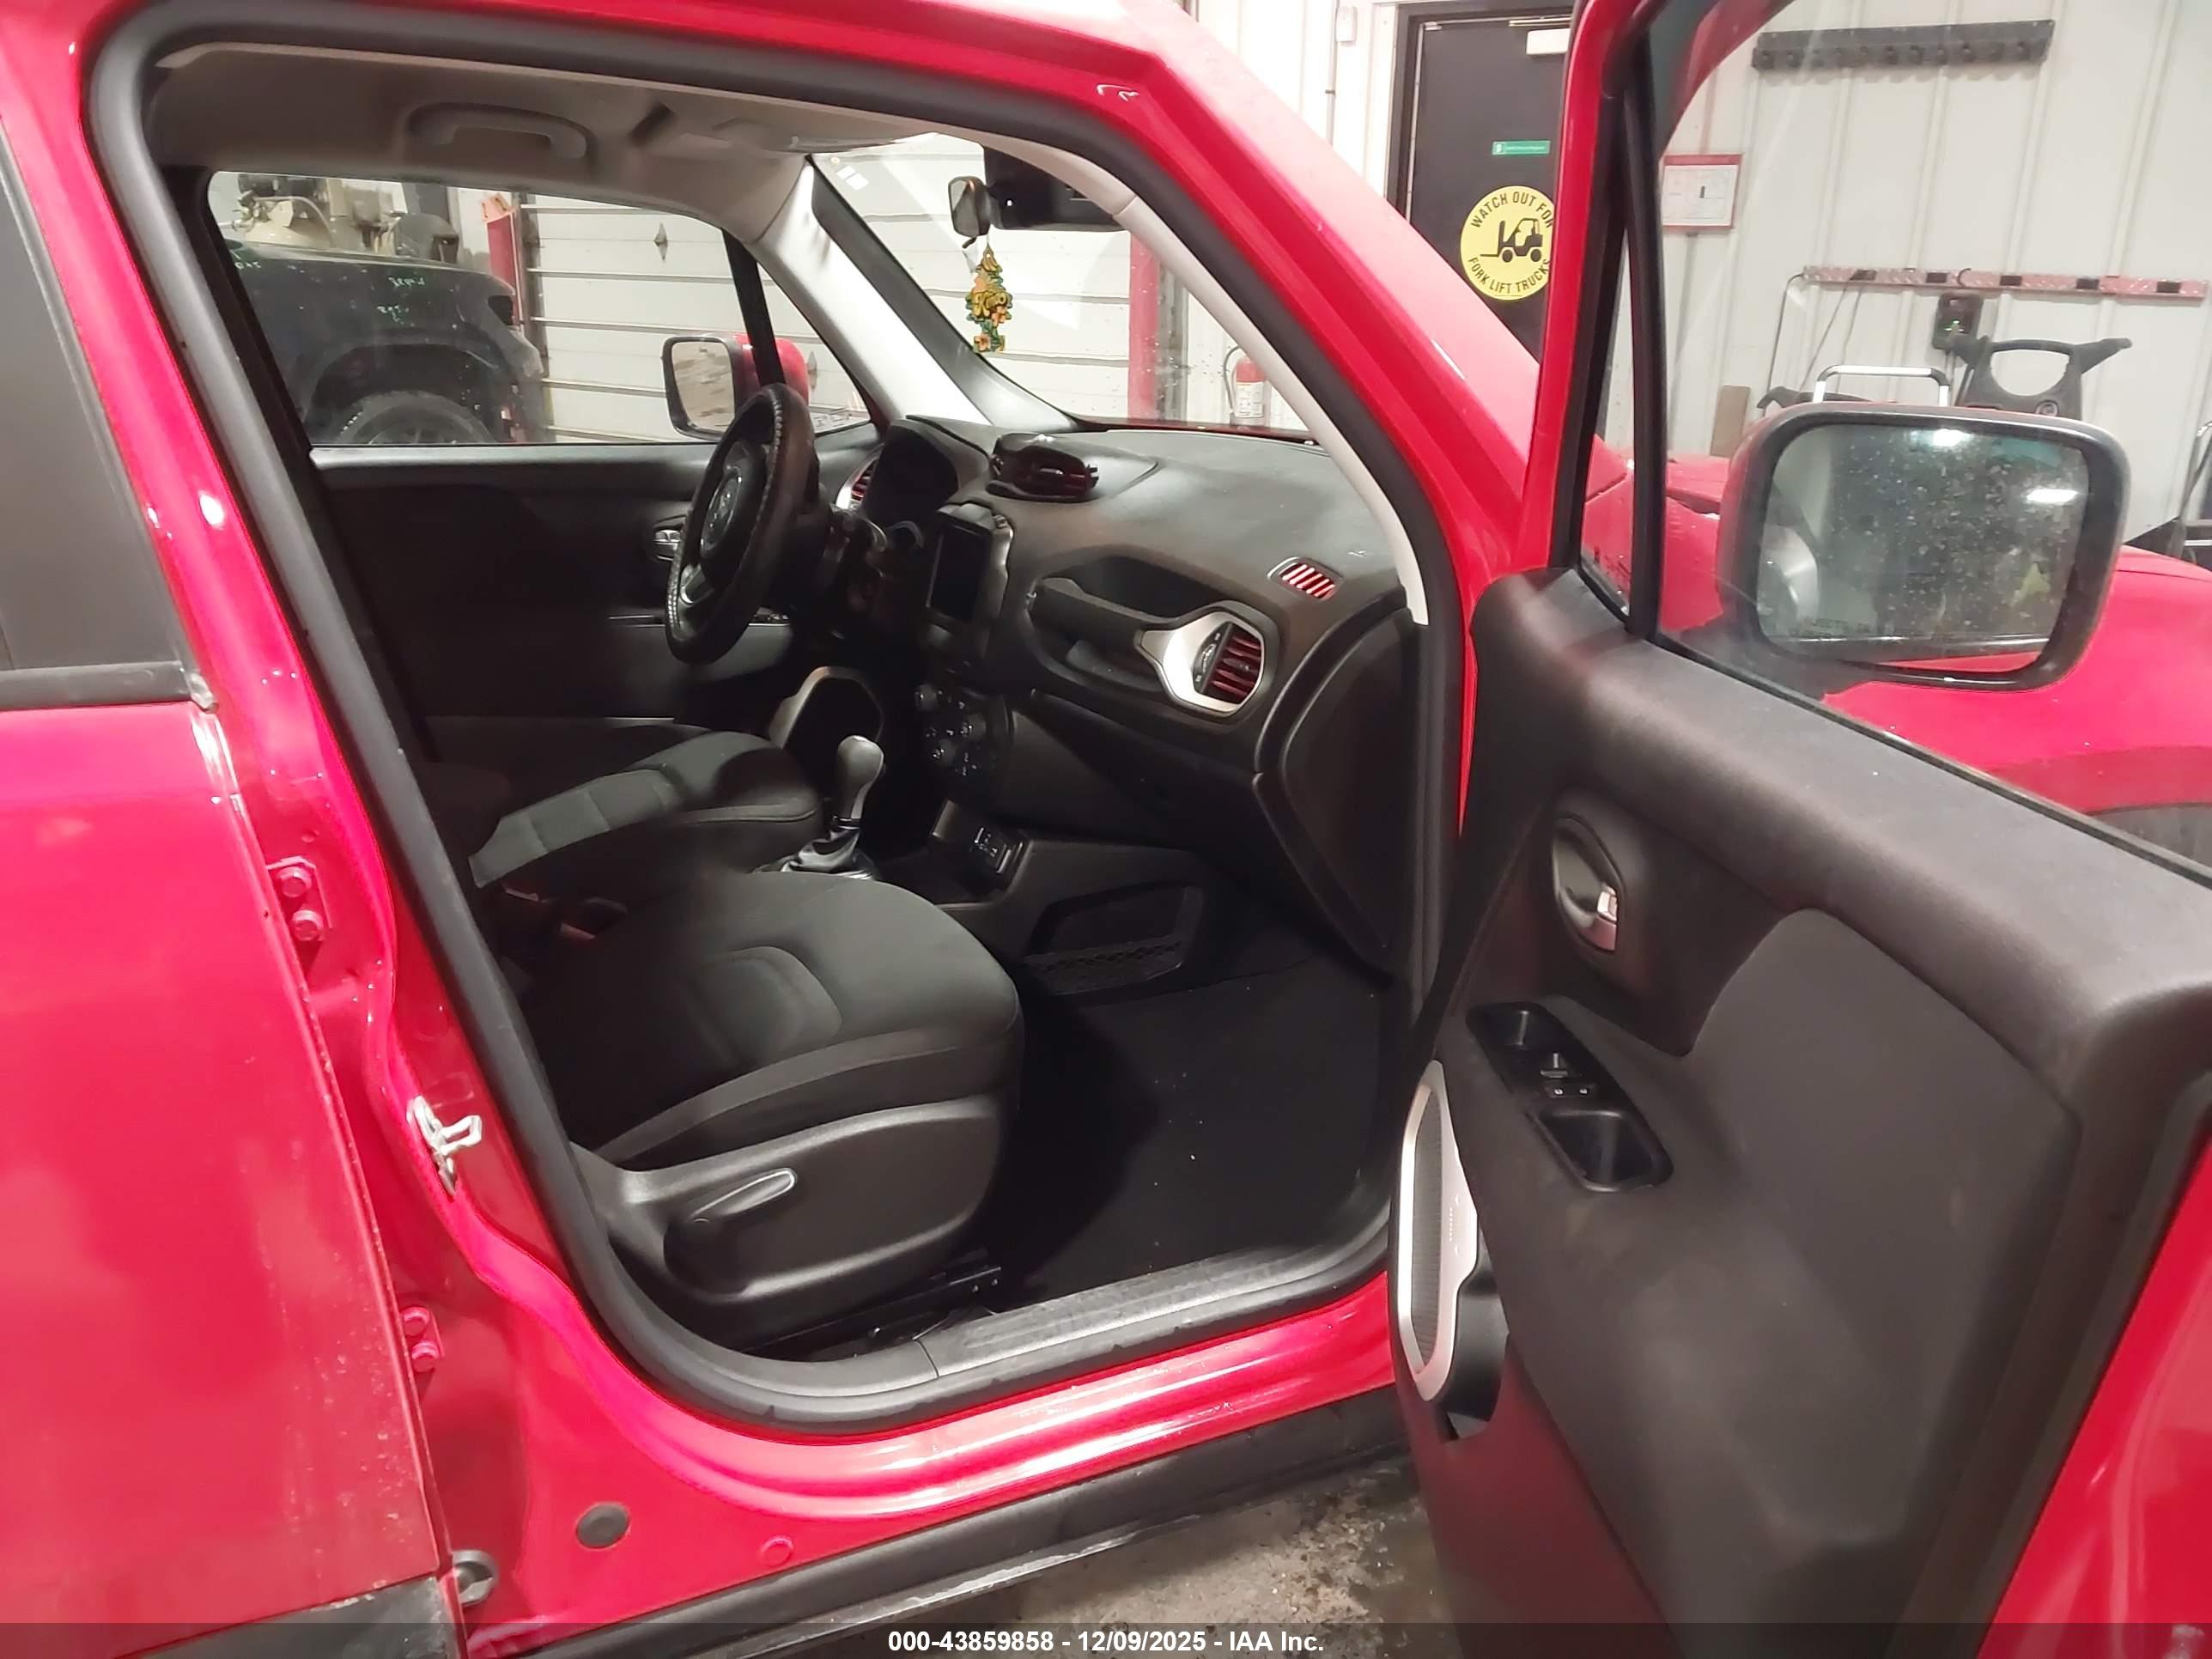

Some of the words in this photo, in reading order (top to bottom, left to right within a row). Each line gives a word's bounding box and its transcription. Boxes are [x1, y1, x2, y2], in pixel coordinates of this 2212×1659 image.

[1471, 192, 1509, 228] WATCH
[1512, 191, 1537, 207] OUT
[1468, 257, 1491, 284] FORK
[1489, 279, 1512, 294] LIFT
